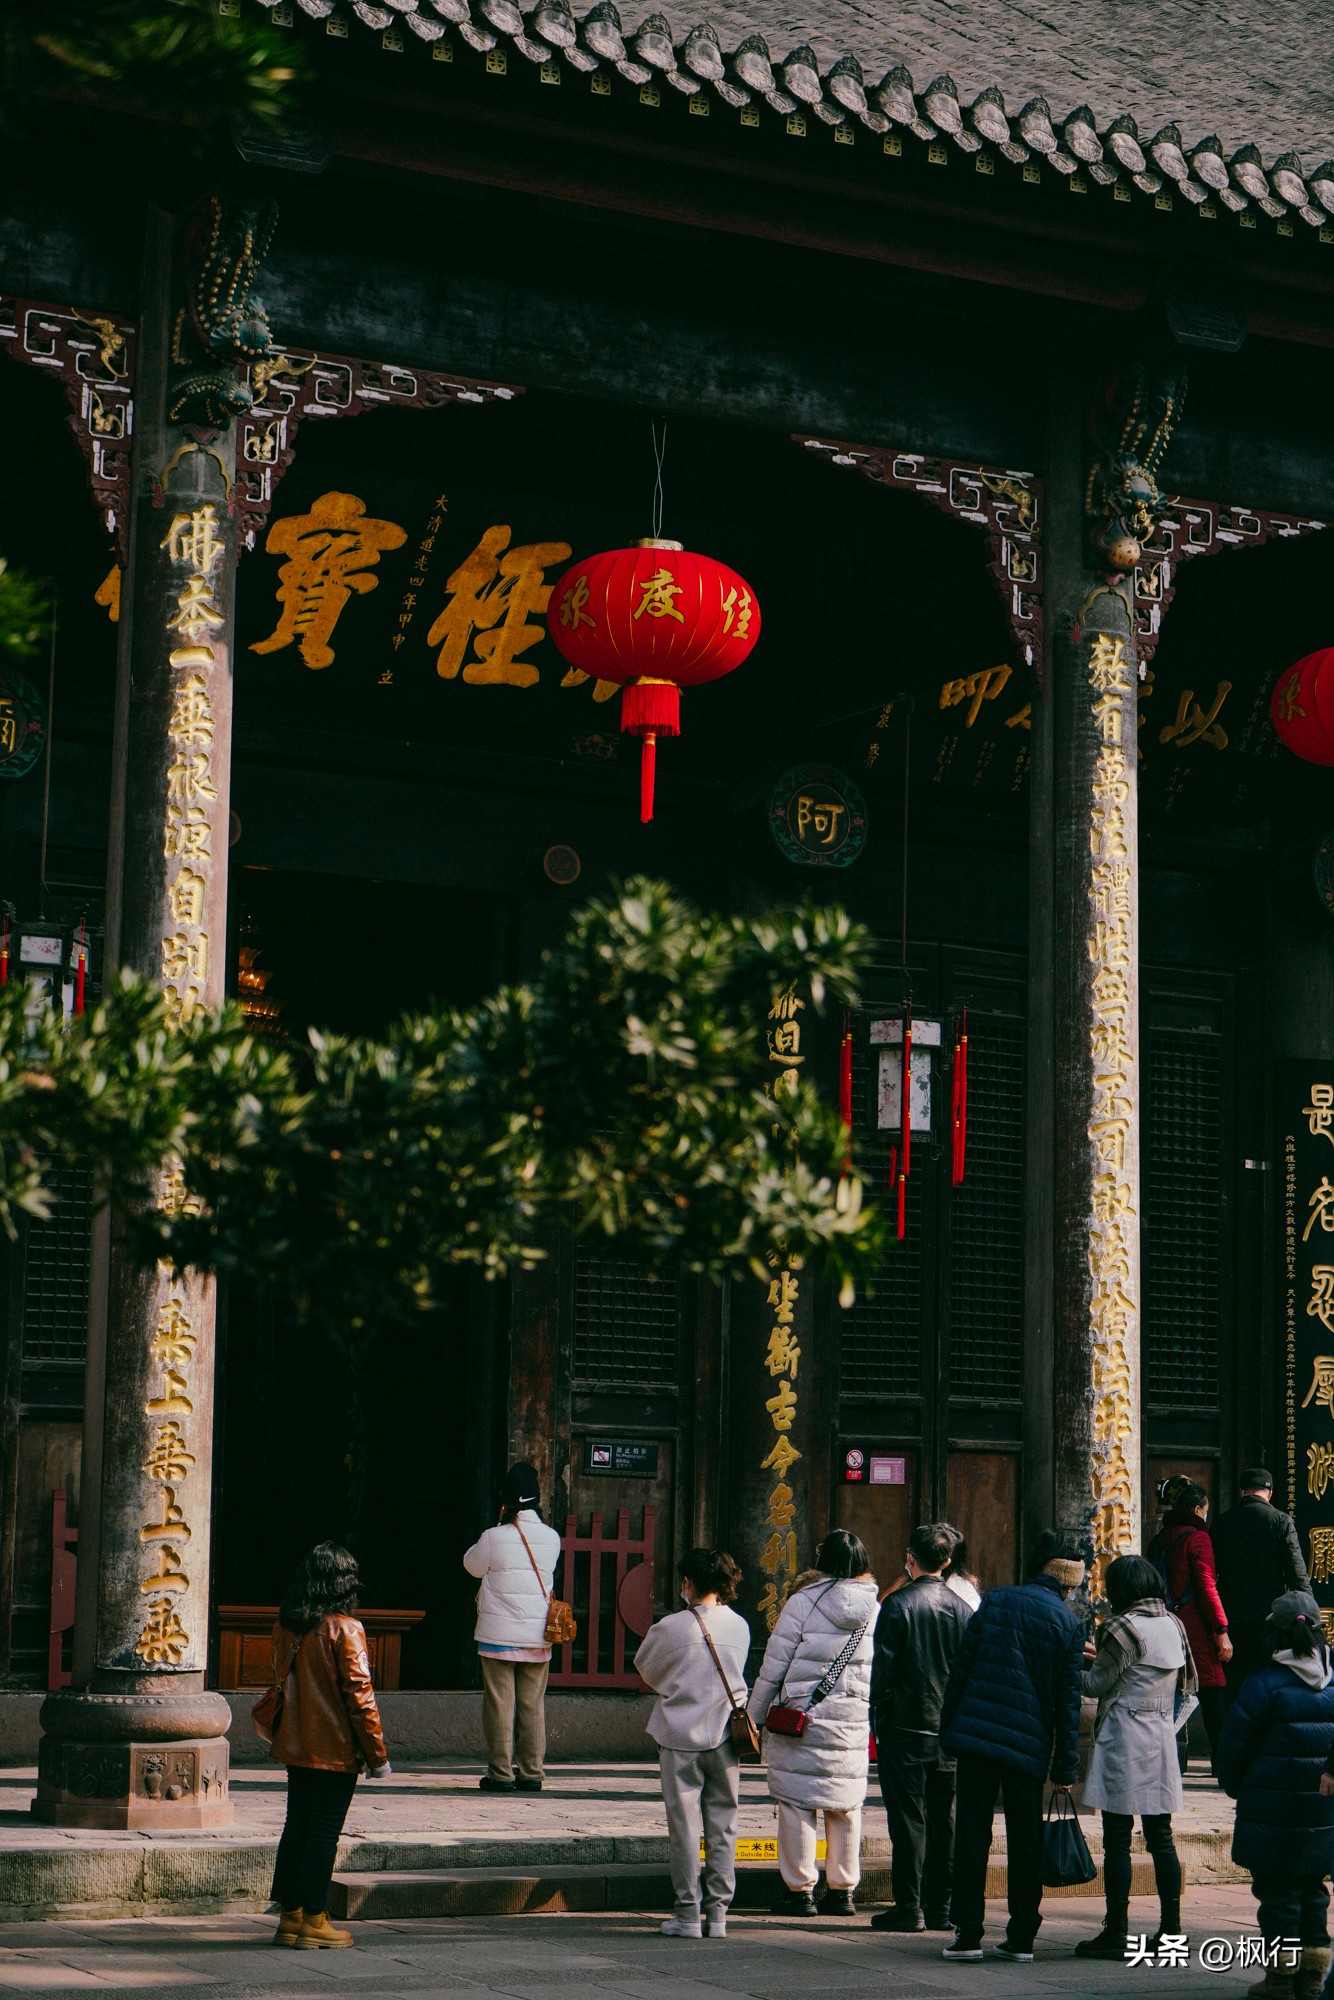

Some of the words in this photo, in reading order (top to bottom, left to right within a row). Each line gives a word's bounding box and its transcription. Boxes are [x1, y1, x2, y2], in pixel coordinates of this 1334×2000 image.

[798, 796, 845, 843] 阿
[738, 1842, 776, 1852] 一米线
